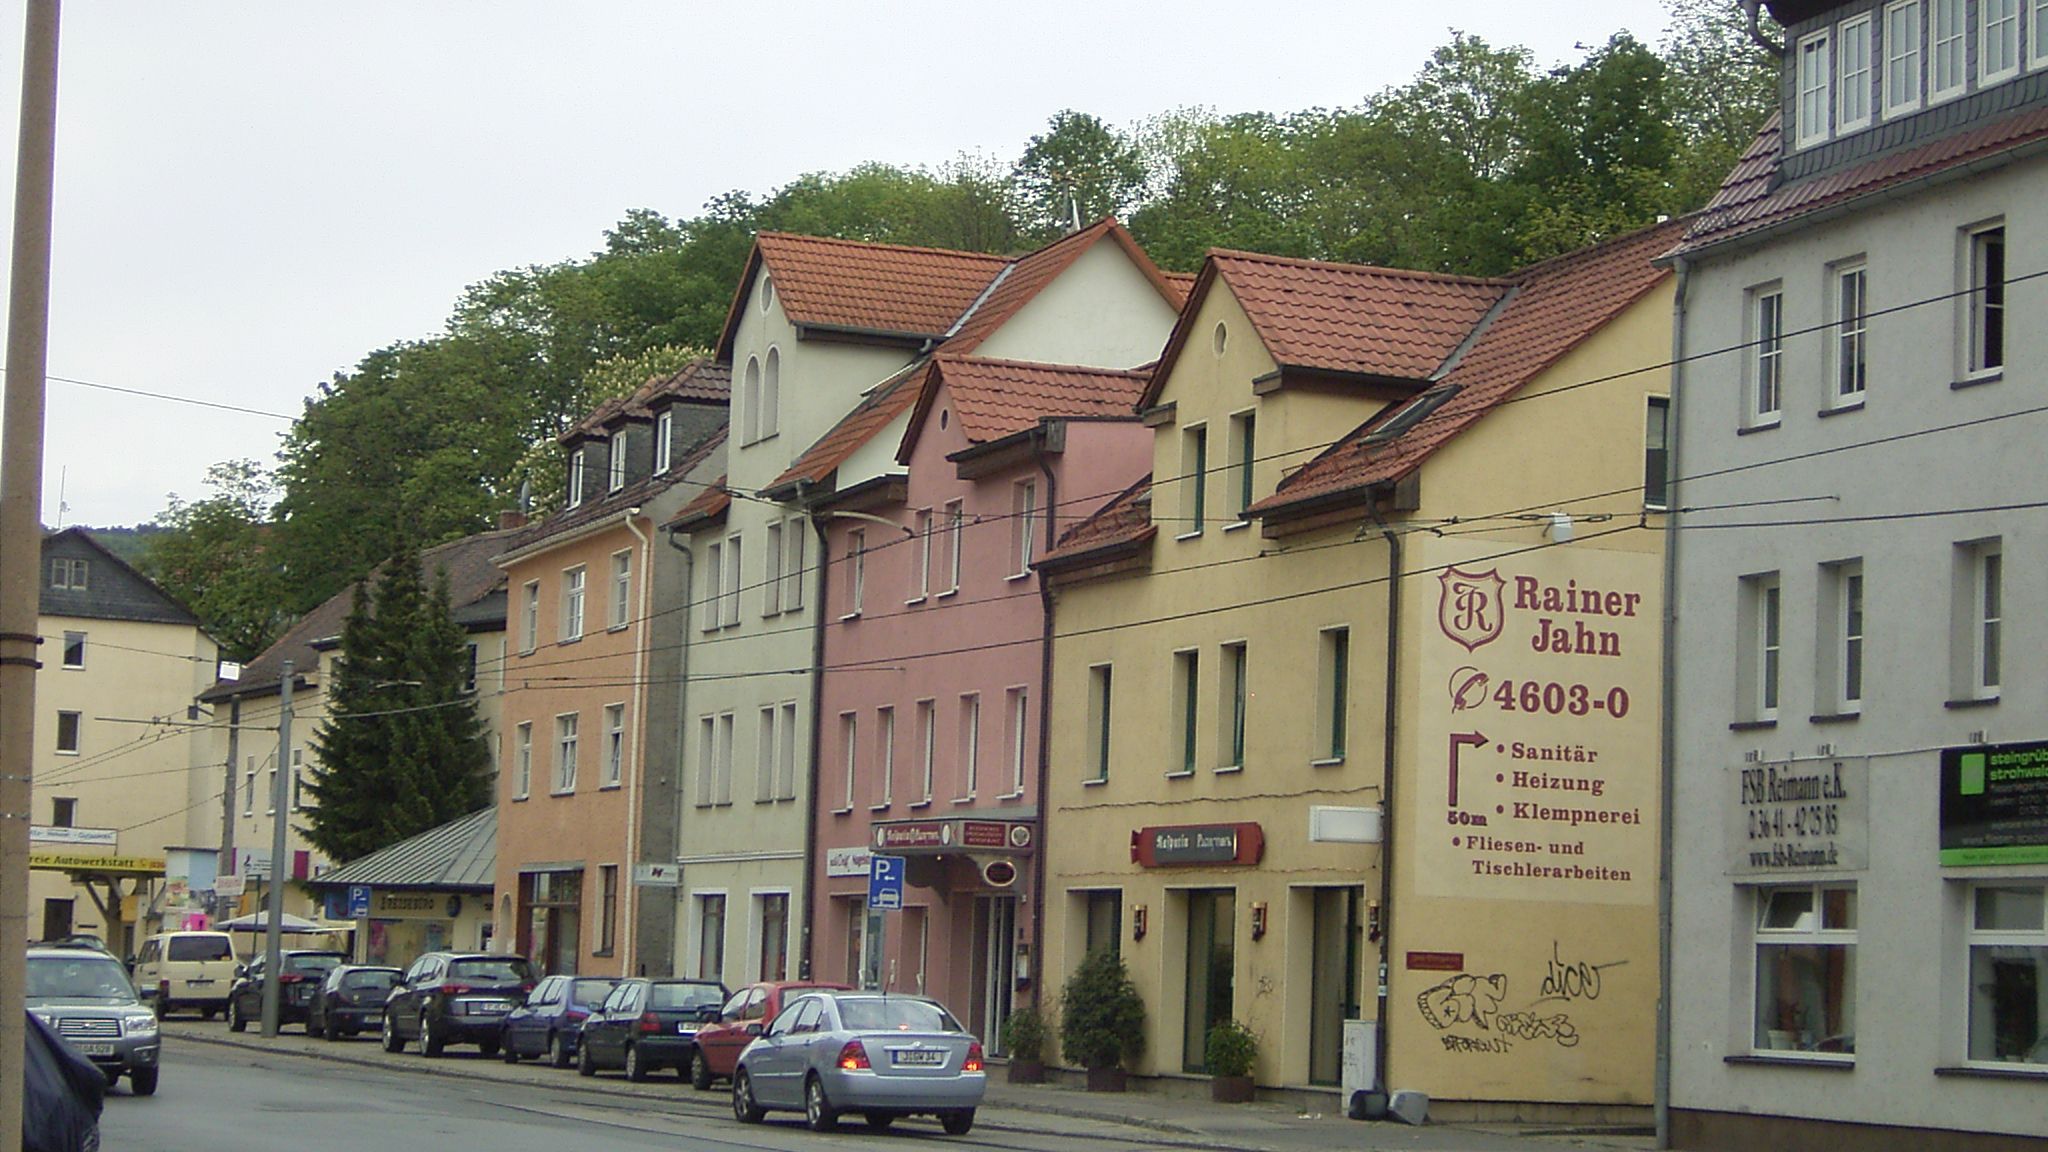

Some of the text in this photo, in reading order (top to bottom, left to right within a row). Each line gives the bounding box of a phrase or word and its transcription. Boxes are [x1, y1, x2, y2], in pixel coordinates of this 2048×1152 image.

[1514, 576, 1641, 617] Rainer
[1531, 618, 1621, 656] Jahn
[1493, 680, 1629, 718] 4603-0
[1511, 742, 1598, 763] Sanitär
[1512, 771, 1605, 796] Heizung
[1742, 768, 1765, 804] FSB
[1768, 765, 1819, 802] Reimann
[1447, 811, 1488, 826] 50m
[1513, 802, 1640, 826] Klempnerei
[1467, 836, 1584, 855] Fliesen- und
[54, 856, 134, 868] Autowerkstatt
[875, 859, 891, 880] P
[1472, 860, 1631, 881] Tischlerarbeiten
[353, 888, 363, 900] P
